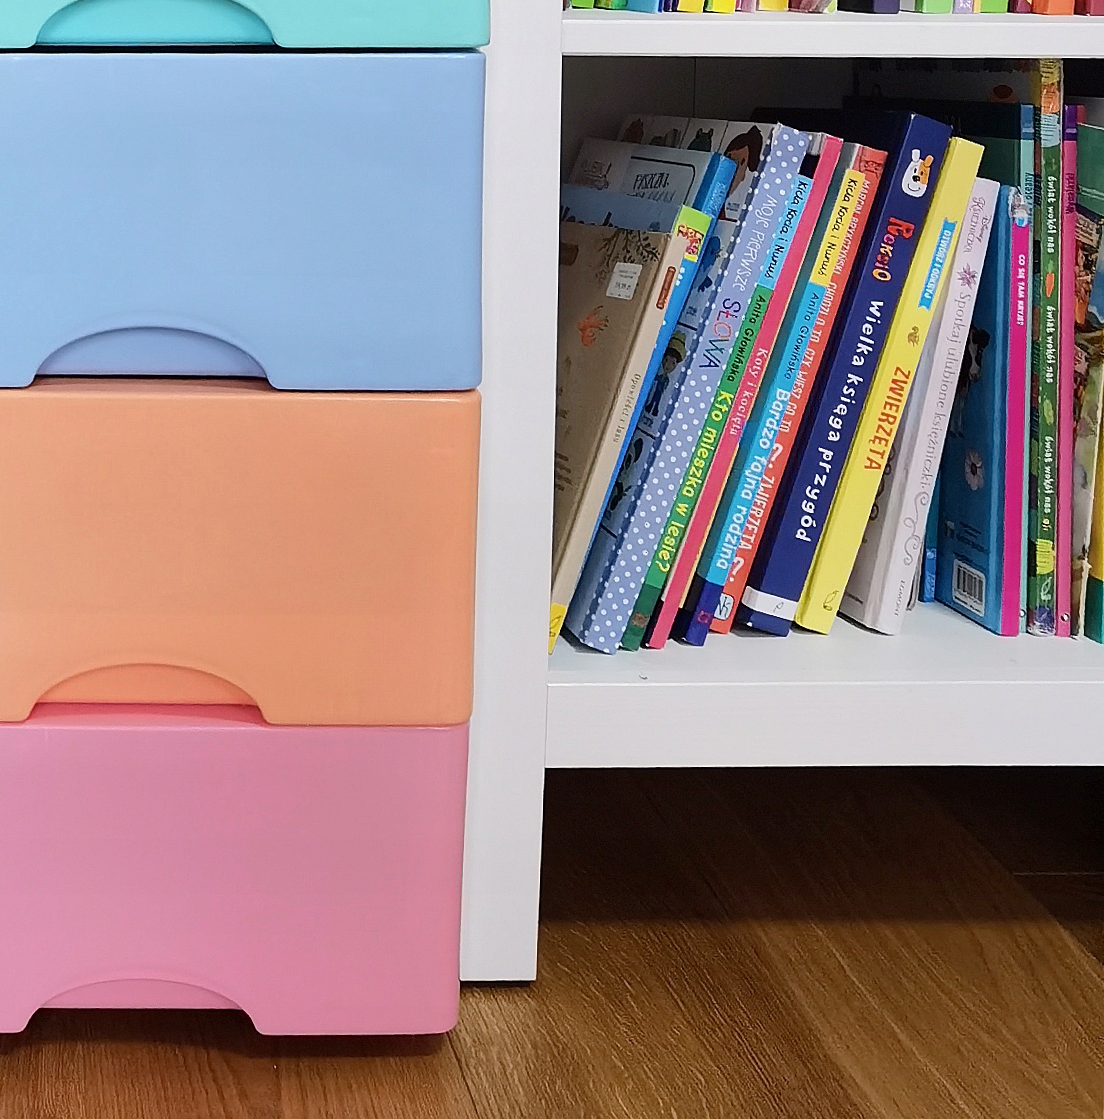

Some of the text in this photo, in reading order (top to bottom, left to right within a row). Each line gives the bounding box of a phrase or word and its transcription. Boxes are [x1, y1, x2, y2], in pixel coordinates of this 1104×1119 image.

[791, 179, 809, 205] Kicia
[841, 178, 858, 202] Kicia
[779, 208, 801, 235] Kocia
[831, 205, 849, 233] Kocia
[1046, 206, 1057, 234] wokół
[1018, 254, 1025, 266] CO
[1017, 281, 1025, 298] TAM
[699, 298, 742, 368] SŁOWA
[783, 292, 820, 380] Anita Głowińska
[947, 291, 971, 344] Spotkaj
[727, 294, 767, 382] Anita Głowińska
[1045, 336, 1056, 364] wokół
[748, 347, 768, 378] Koty
[937, 347, 959, 409] ulubione
[1045, 366, 1054, 384] nas
[621, 373, 642, 416] Opowieści
[826, 372, 864, 443] księga
[729, 391, 754, 436] kocięta
[863, 366, 912, 471] ZWIERZĘTA
[654, 391, 734, 573] Kto mieszka w lesie?
[715, 388, 791, 569] Bardzo fajna rodzina
[794, 445, 836, 543] przygód
[1043, 465, 1054, 494] wokół
[1044, 496, 1052, 514] nas
